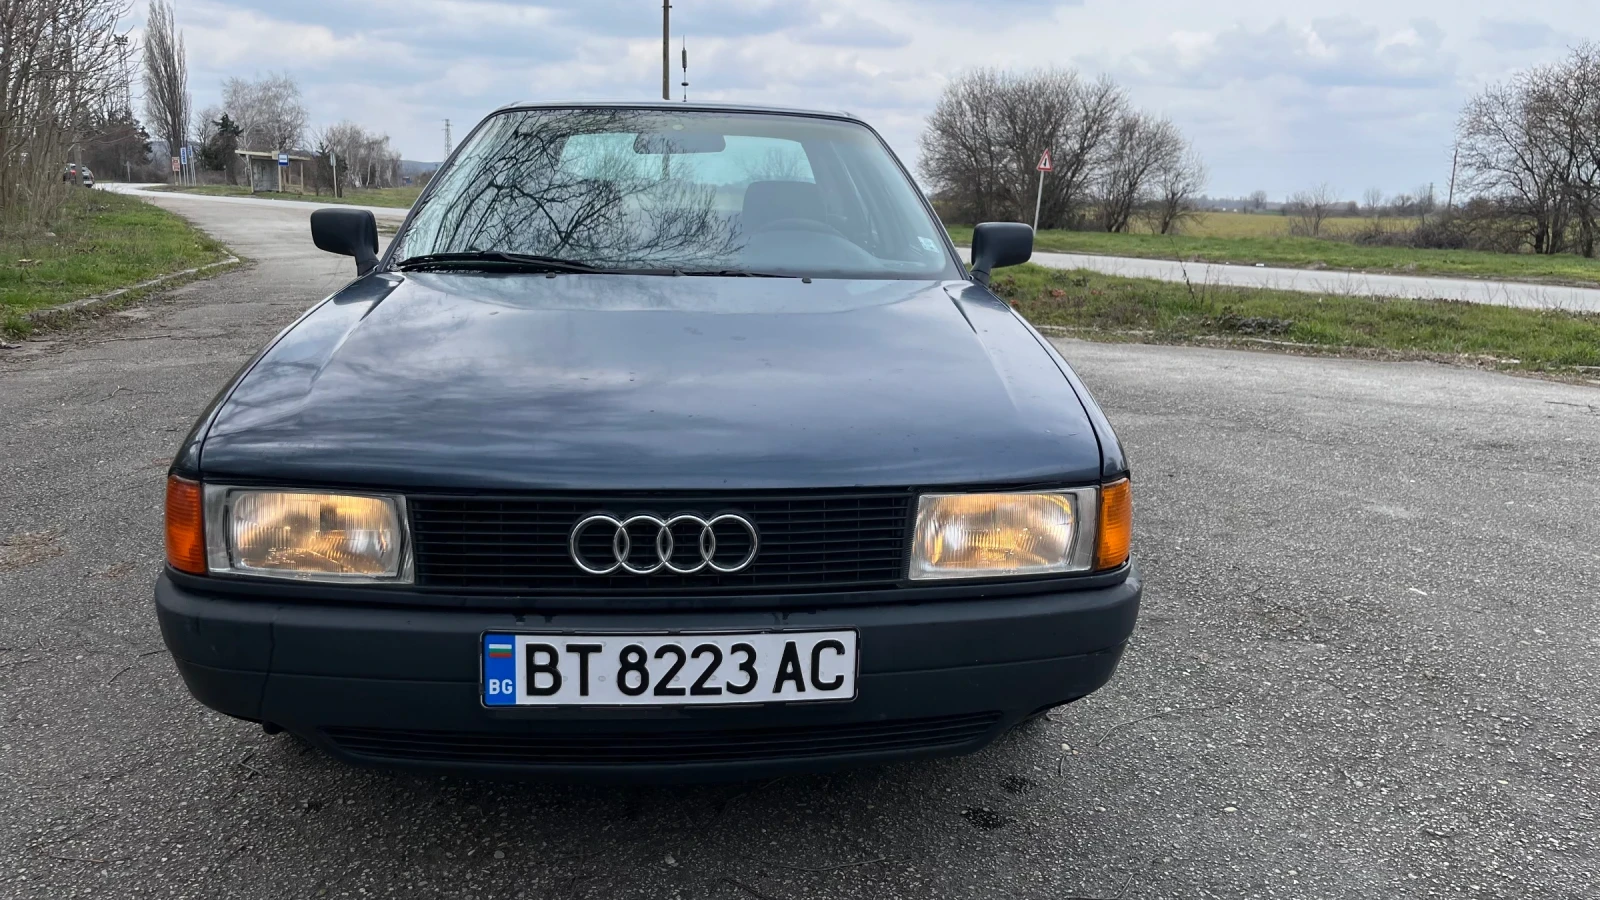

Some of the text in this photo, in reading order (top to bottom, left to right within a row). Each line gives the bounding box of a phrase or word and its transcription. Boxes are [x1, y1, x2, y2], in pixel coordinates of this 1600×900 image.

[525, 640, 846, 697] BT 8223 AC
[489, 679, 513, 695] BG
